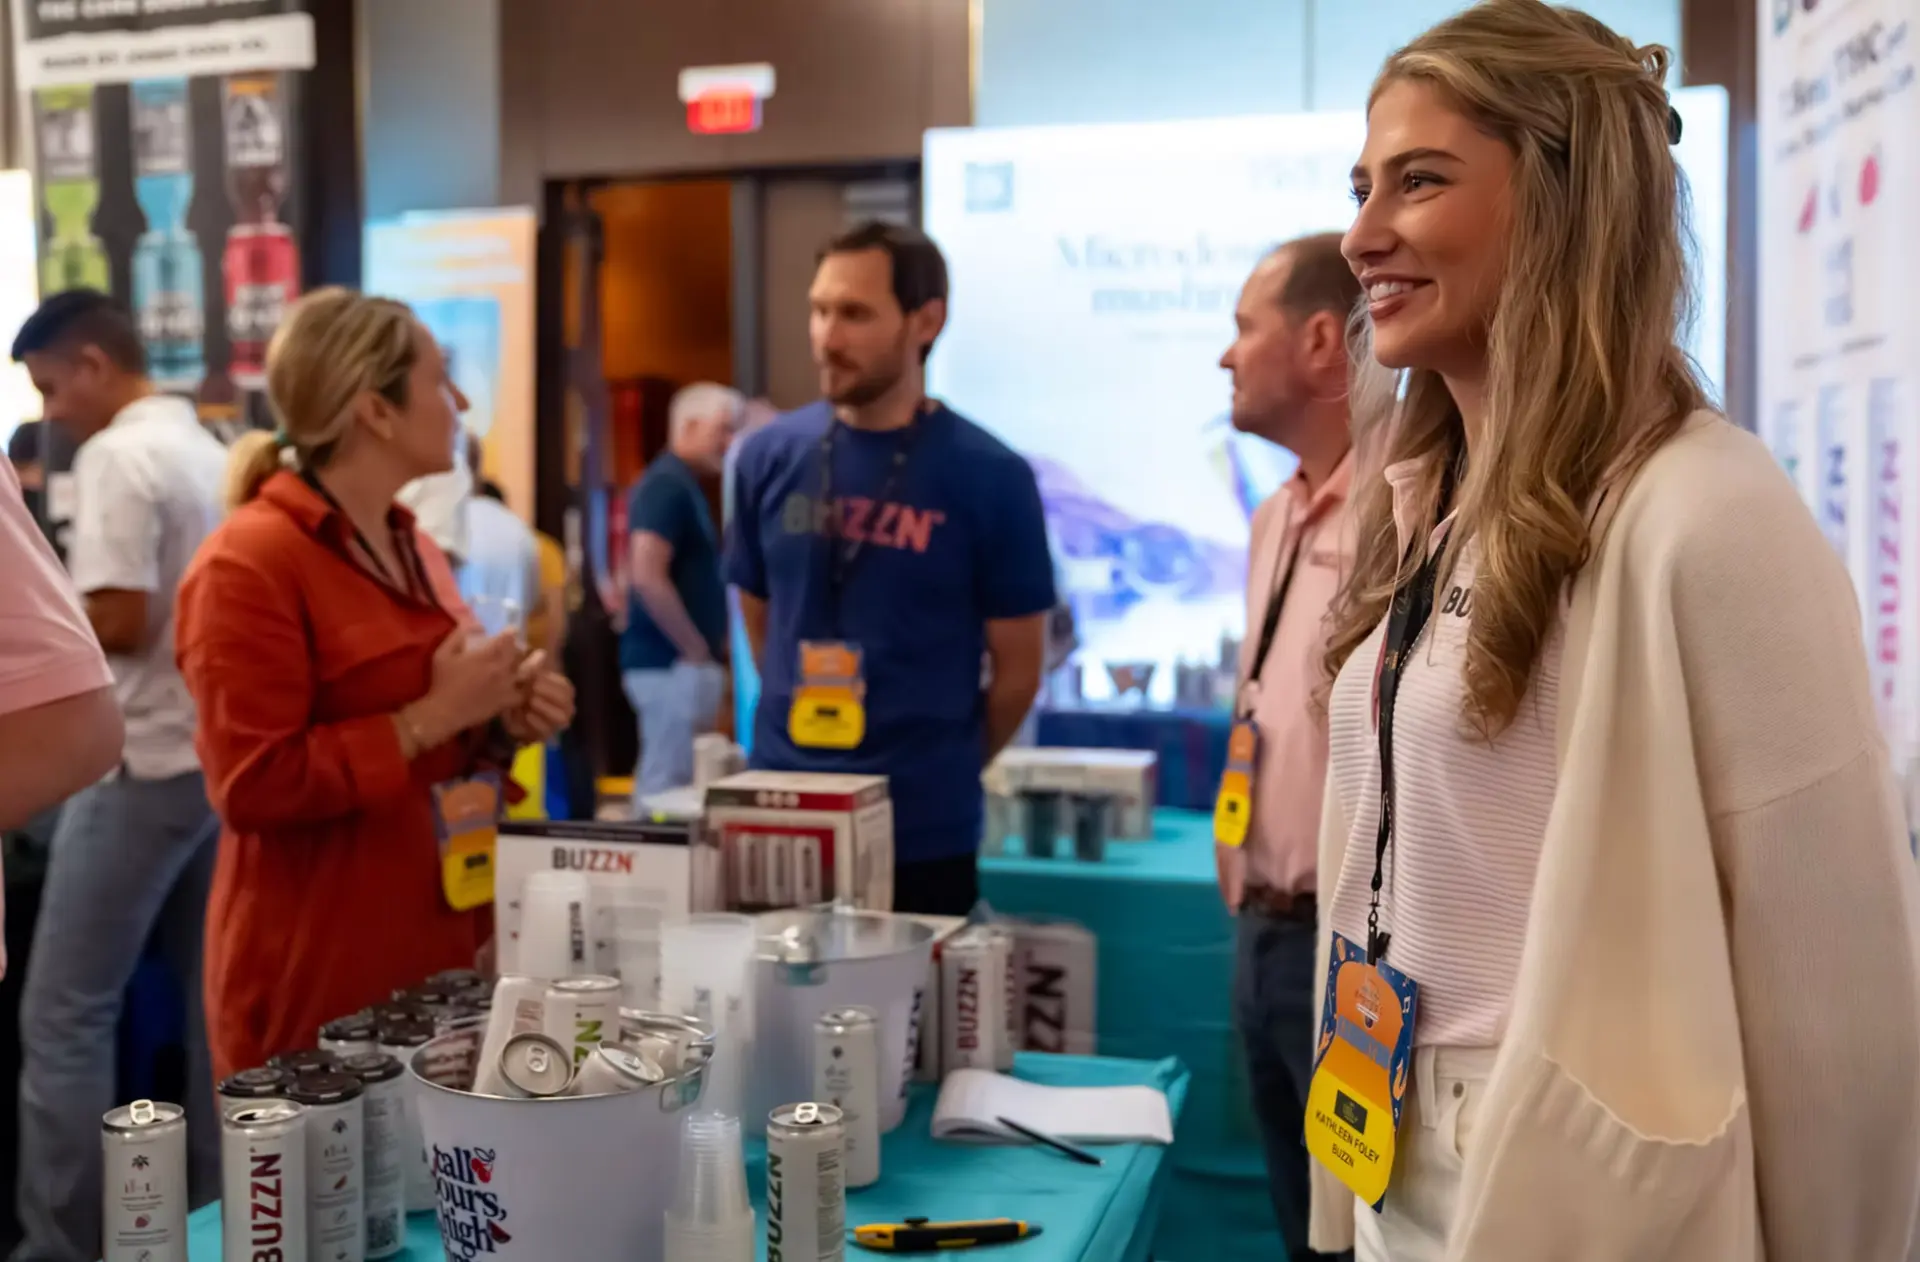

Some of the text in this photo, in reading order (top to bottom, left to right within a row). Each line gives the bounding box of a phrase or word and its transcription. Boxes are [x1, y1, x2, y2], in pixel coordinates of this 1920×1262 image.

[1876, 438, 1899, 665] BUZZN
[1441, 586, 1473, 618] BU
[552, 846, 634, 874] BUZZN
[957, 967, 979, 1049] BUZZN
[1024, 964, 1066, 1052] ZZN
[1315, 1108, 1354, 1146] KATHLEEN
[1354, 1138, 1380, 1165] FOLEY
[1332, 1143, 1355, 1169] BUZZN
[250, 1153, 283, 1262] BUZZN
[436, 1177, 507, 1222] ours,
[767, 1151, 783, 1262] BUZZN
